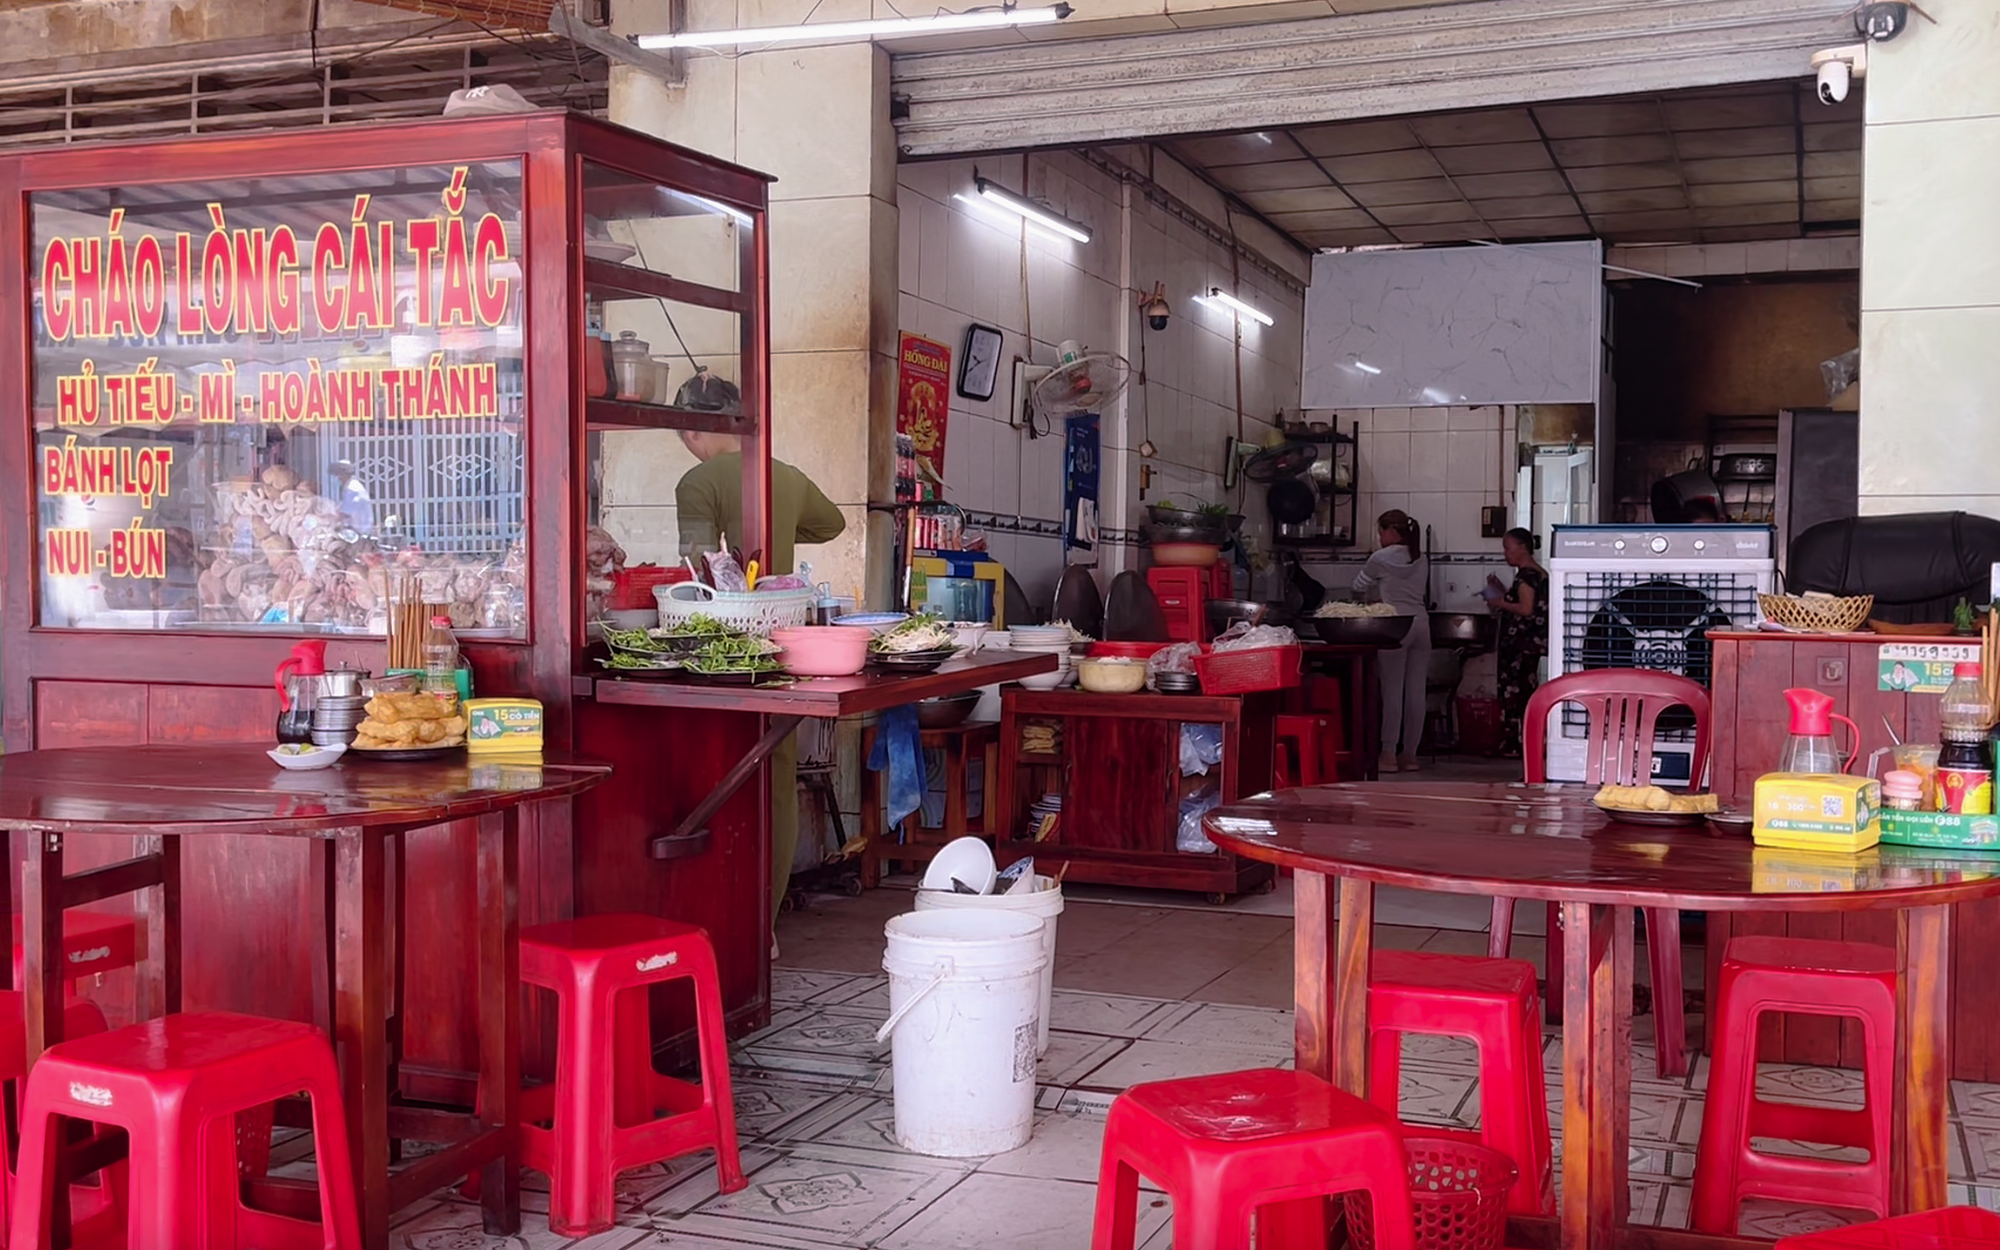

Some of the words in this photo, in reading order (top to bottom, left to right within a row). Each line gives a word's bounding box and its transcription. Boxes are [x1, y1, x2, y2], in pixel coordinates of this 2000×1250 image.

[42, 208, 165, 341] CHÁO
[176, 203, 301, 336] LÒNG
[311, 195, 396, 331] CÁI
[407, 167, 510, 326] TẮC
[56, 358, 100, 426] HỦ
[105, 357, 177, 425] TIẾU
[199, 359, 235, 423] MÌ
[259, 358, 374, 422] HOÀNH
[380, 353, 498, 418] THÁNH
[44, 434, 117, 496] BÁNH
[121, 446, 173, 508] LỌT
[47, 529, 91, 576] NUI
[110, 517, 167, 579] BÚN
[1924, 663, 1942, 676] 15
[494, 709, 508, 720] 15
